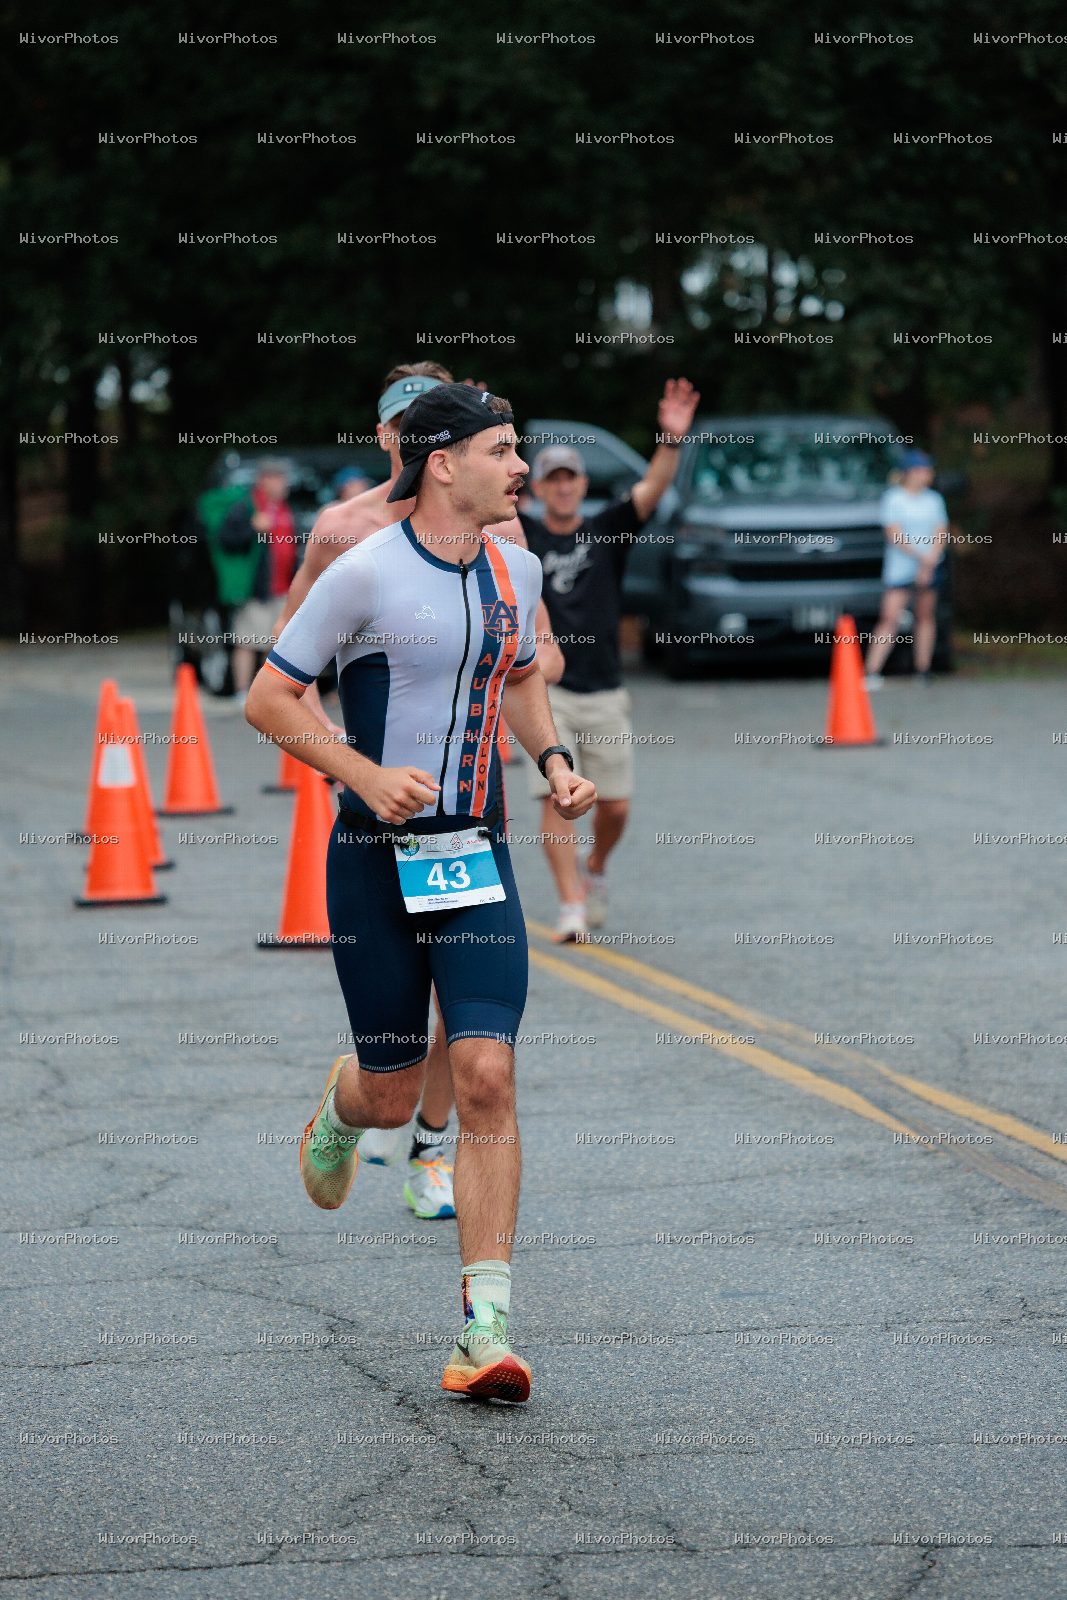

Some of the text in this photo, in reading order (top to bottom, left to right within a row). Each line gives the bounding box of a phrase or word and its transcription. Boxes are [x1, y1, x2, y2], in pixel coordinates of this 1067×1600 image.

[459, 653, 493, 793] AUBURN
[477, 654, 513, 791] TRIATHLON
[427, 861, 471, 890] 43
